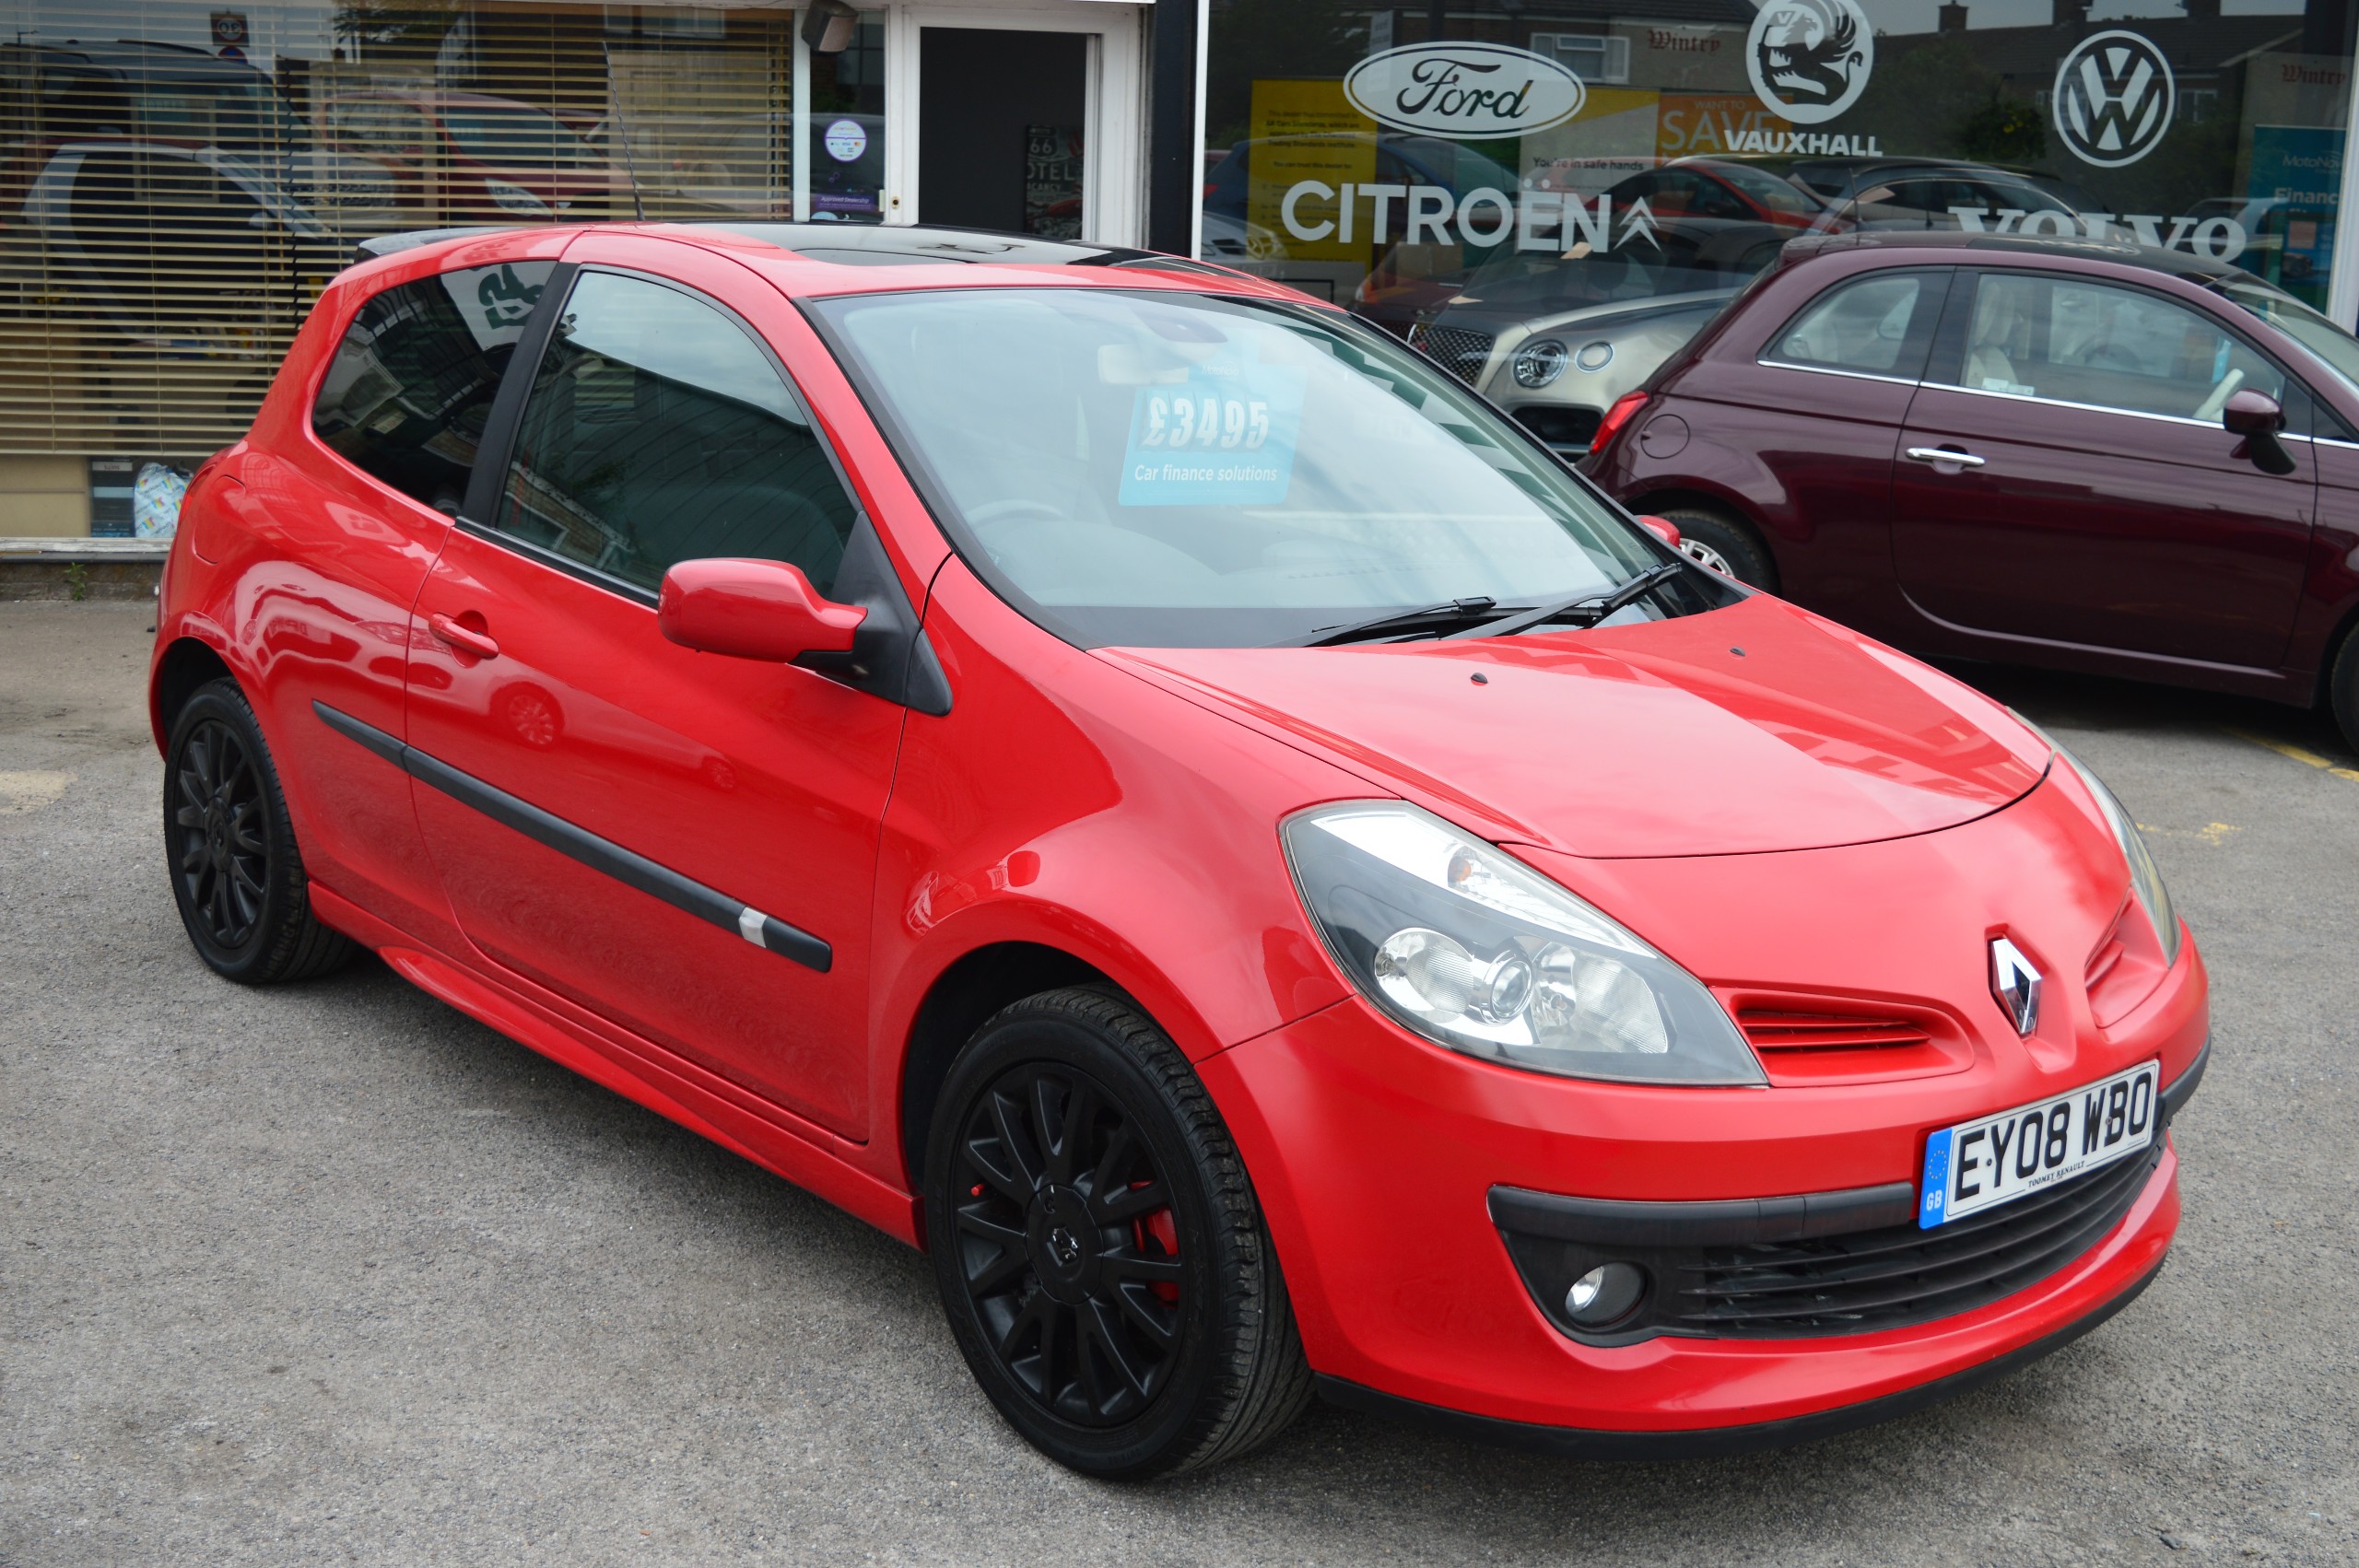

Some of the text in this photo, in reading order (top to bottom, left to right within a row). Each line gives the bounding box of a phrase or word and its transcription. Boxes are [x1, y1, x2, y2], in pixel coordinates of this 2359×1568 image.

[1396, 58, 1533, 120] Ford
[1695, 99, 1747, 111] WANT TO
[1030, 138, 1053, 154] 66
[1724, 129, 1884, 158] VAUXHALL
[1532, 157, 1568, 168] You're
[1583, 158, 1607, 169] safe
[1610, 159, 1644, 170] hands
[1281, 178, 1611, 253] CITROËN
[1142, 396, 1270, 450] £3495
[1134, 463, 1277, 482] Car finance solutions
[1954, 1071, 2152, 1202] EY08 WBO
[2028, 1172, 2055, 1188] TOOMEY
[2056, 1161, 2085, 1177] RENAULT
[1926, 1189, 1942, 1211] GB
